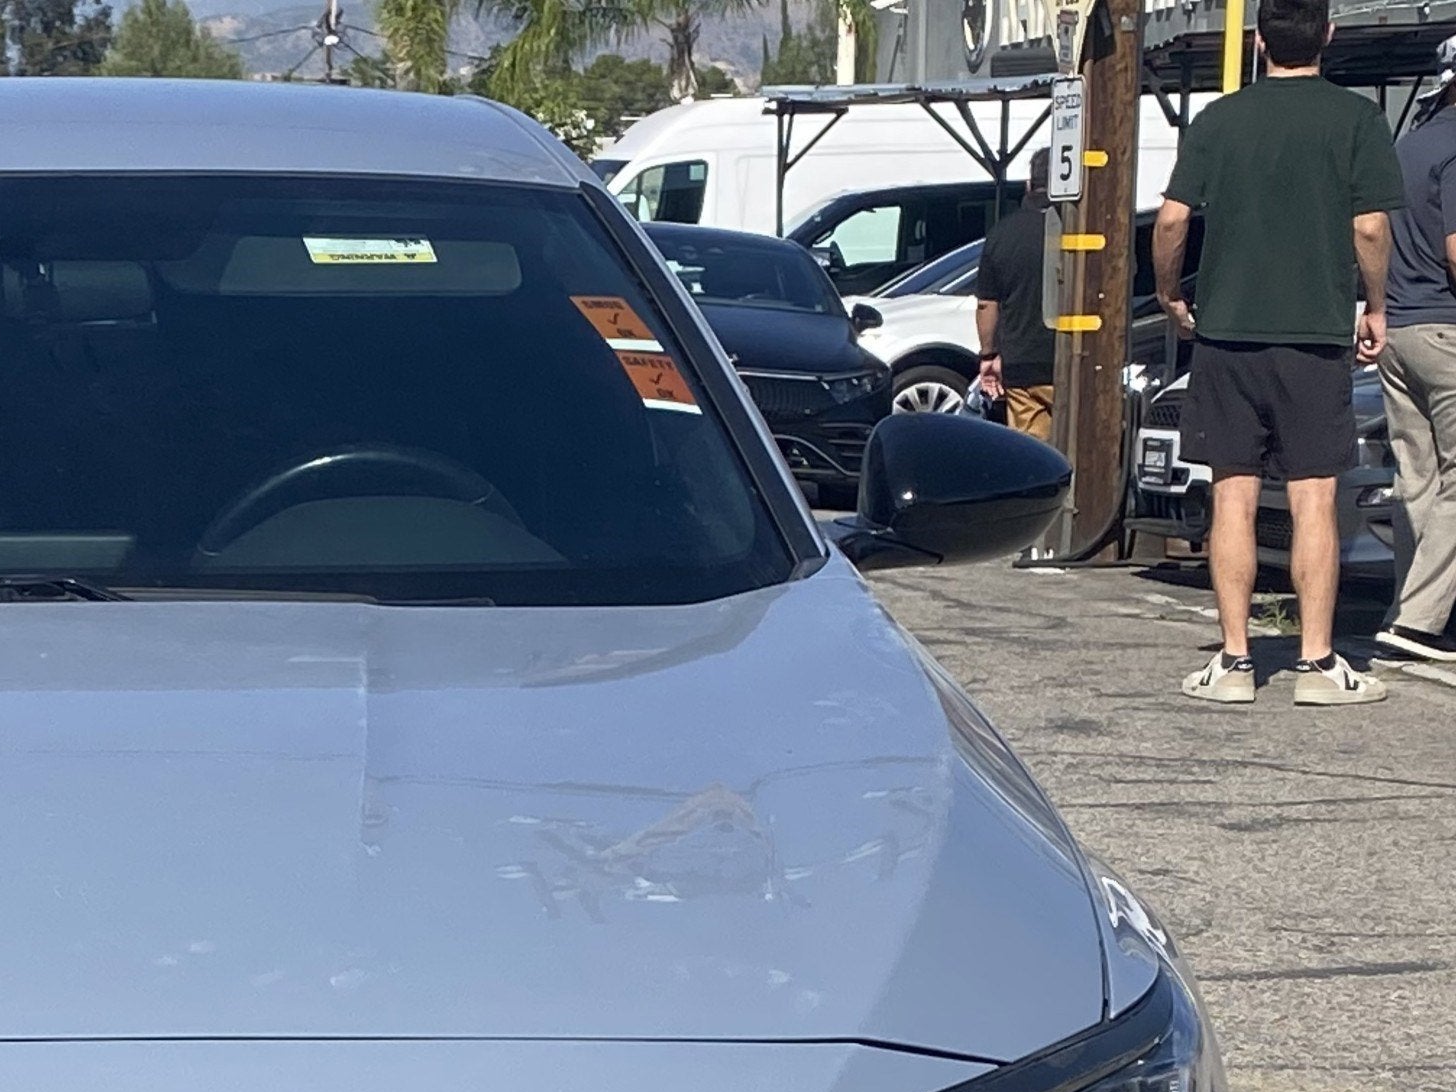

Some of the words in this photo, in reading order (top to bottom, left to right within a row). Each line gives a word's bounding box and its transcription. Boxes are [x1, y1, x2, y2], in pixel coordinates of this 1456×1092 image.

[1055, 94, 1081, 110] SPEED
[1056, 114, 1079, 130] LIMIT
[1060, 145, 1073, 181] 5
[622, 356, 675, 370] SAFETY
